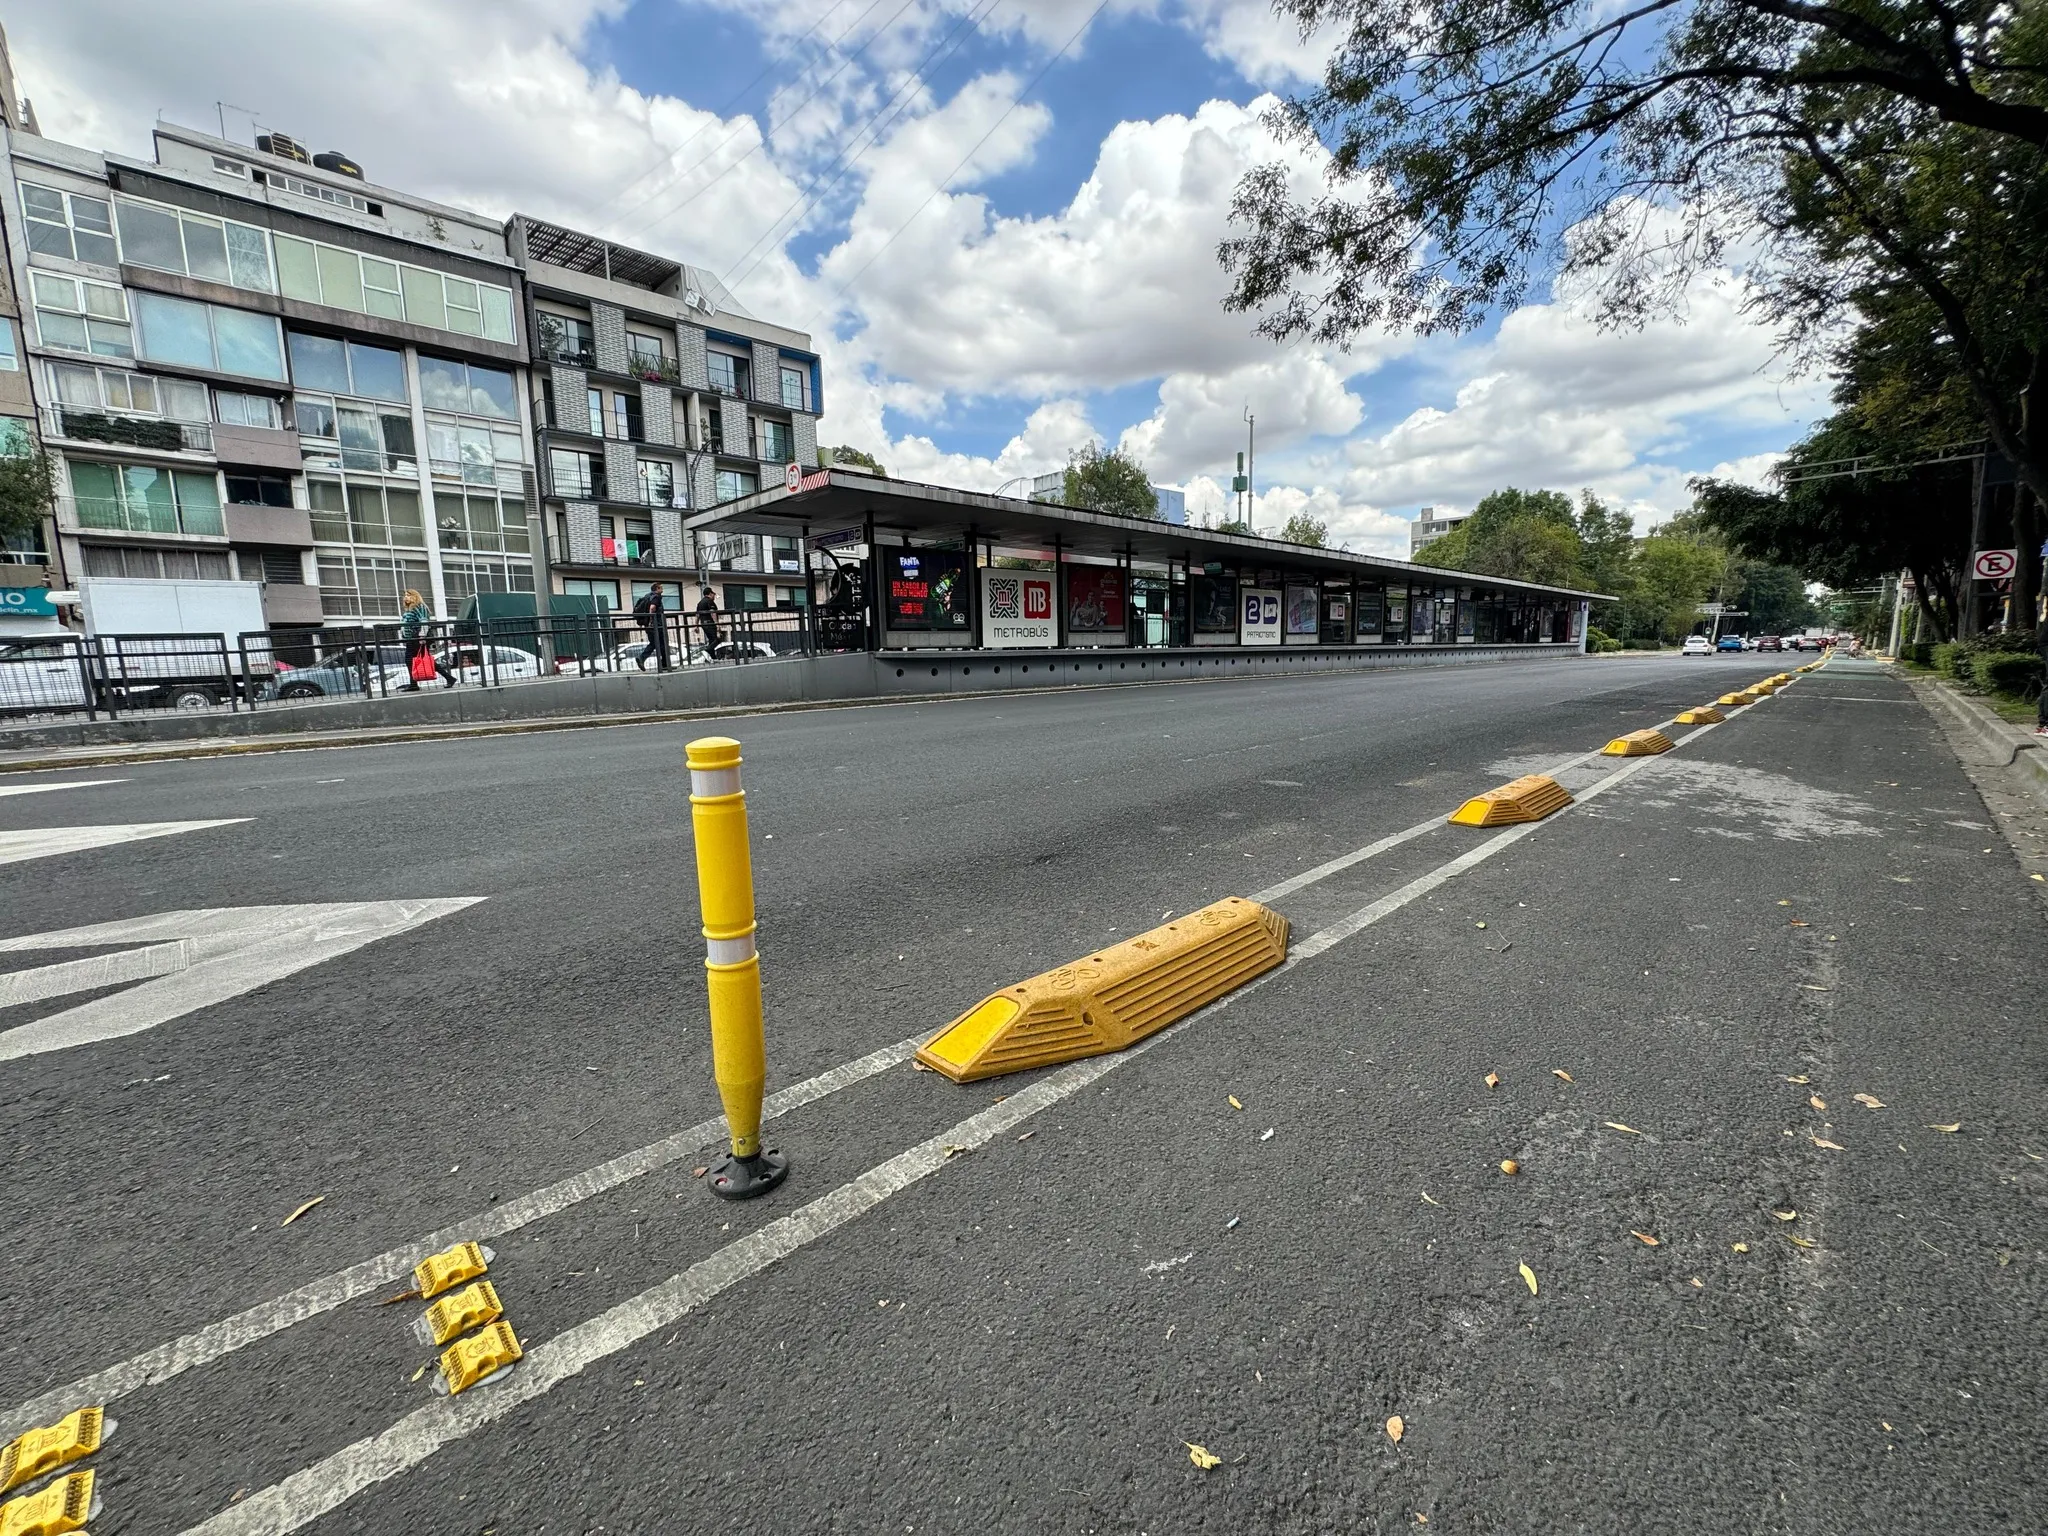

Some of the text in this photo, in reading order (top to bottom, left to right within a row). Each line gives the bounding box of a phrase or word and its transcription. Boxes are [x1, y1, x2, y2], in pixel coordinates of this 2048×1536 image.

[899, 556, 920, 566] FANTA
[1988, 557, 2003, 571] E
[901, 581, 920, 590] SABOR
[1028, 587, 1047, 613] MB
[1248, 599, 1258, 620] 2
[993, 625, 1049, 638] METROBÚS
